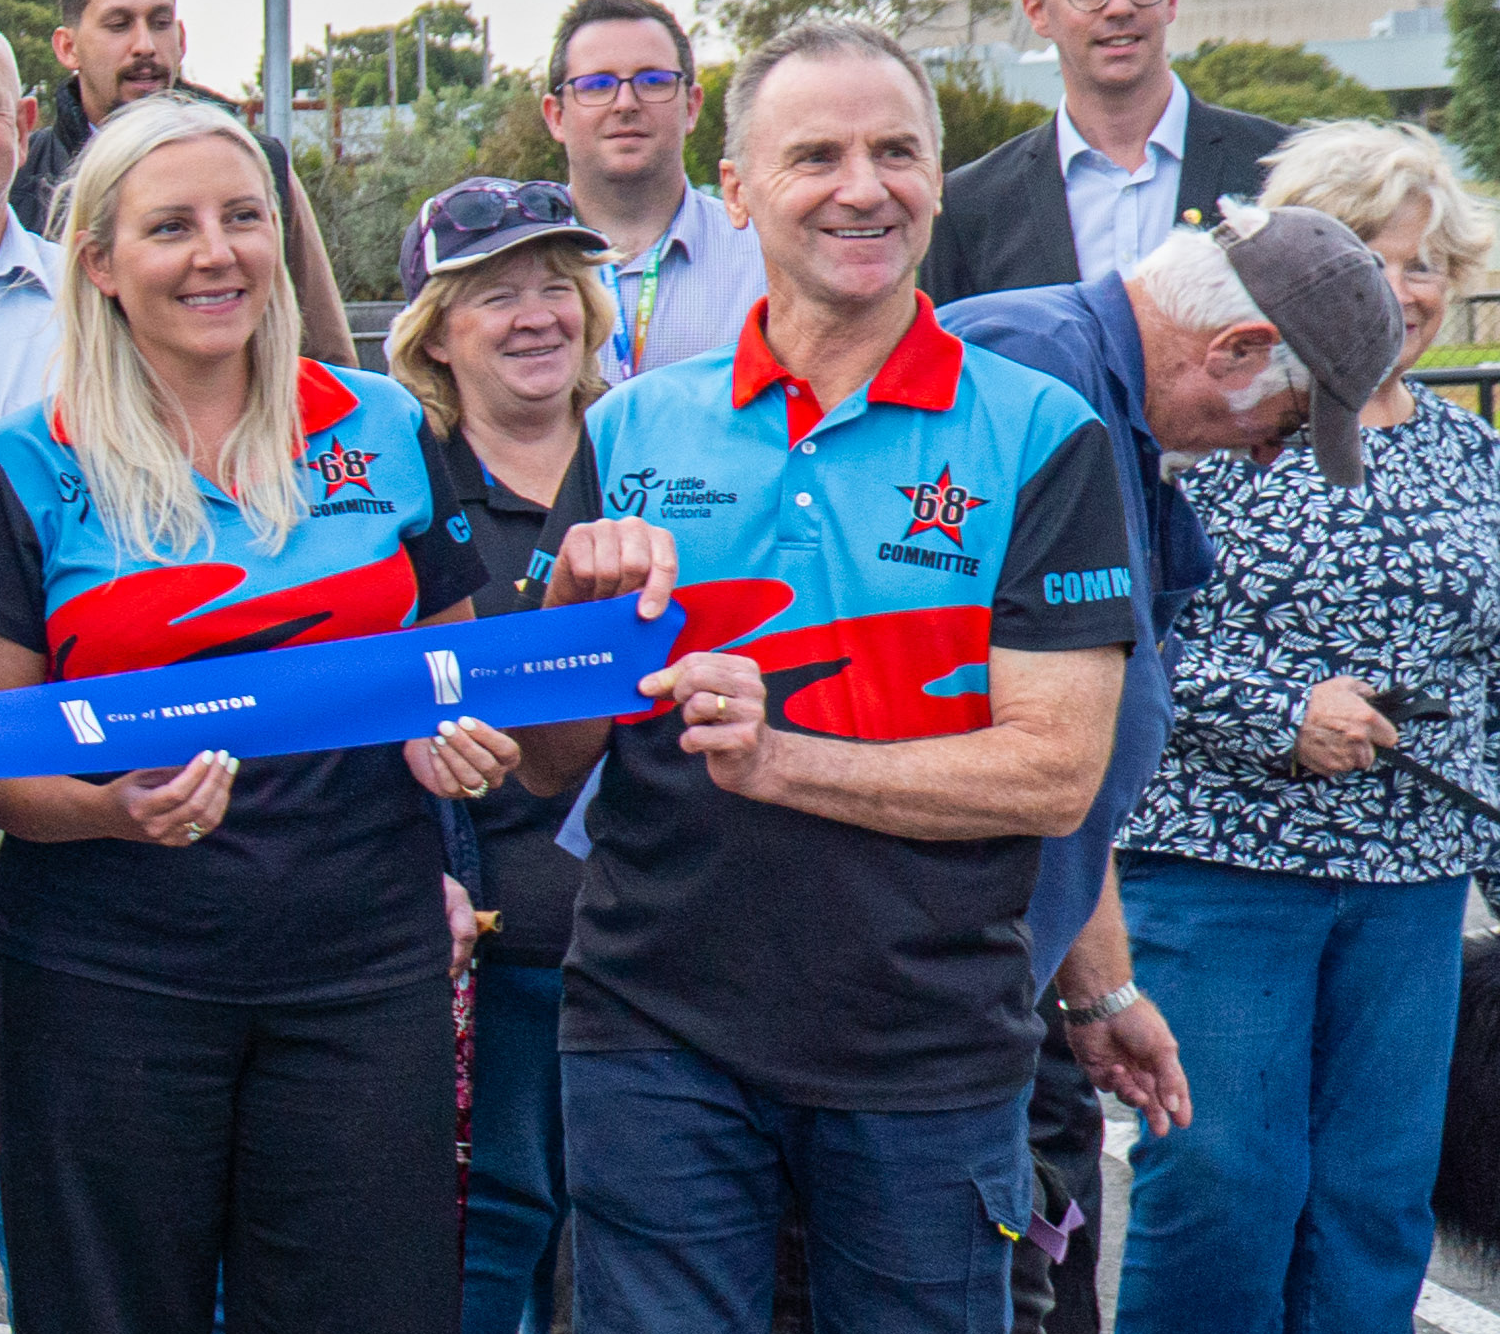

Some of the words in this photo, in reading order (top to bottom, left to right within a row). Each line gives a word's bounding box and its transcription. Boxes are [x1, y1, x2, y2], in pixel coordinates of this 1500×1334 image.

[318, 449, 368, 484] 68
[666, 477, 706, 492] Little
[309, 498, 397, 517] COMMITTEE
[661, 490, 738, 506] Athletics
[913, 483, 968, 526] 68
[660, 506, 712, 519] Victoria
[878, 542, 981, 577] COMMITTEE
[523, 652, 614, 674] KINGSTON
[107, 713, 136, 722] City
[142, 709, 156, 719] of
[161, 695, 257, 718] KINGSTON
